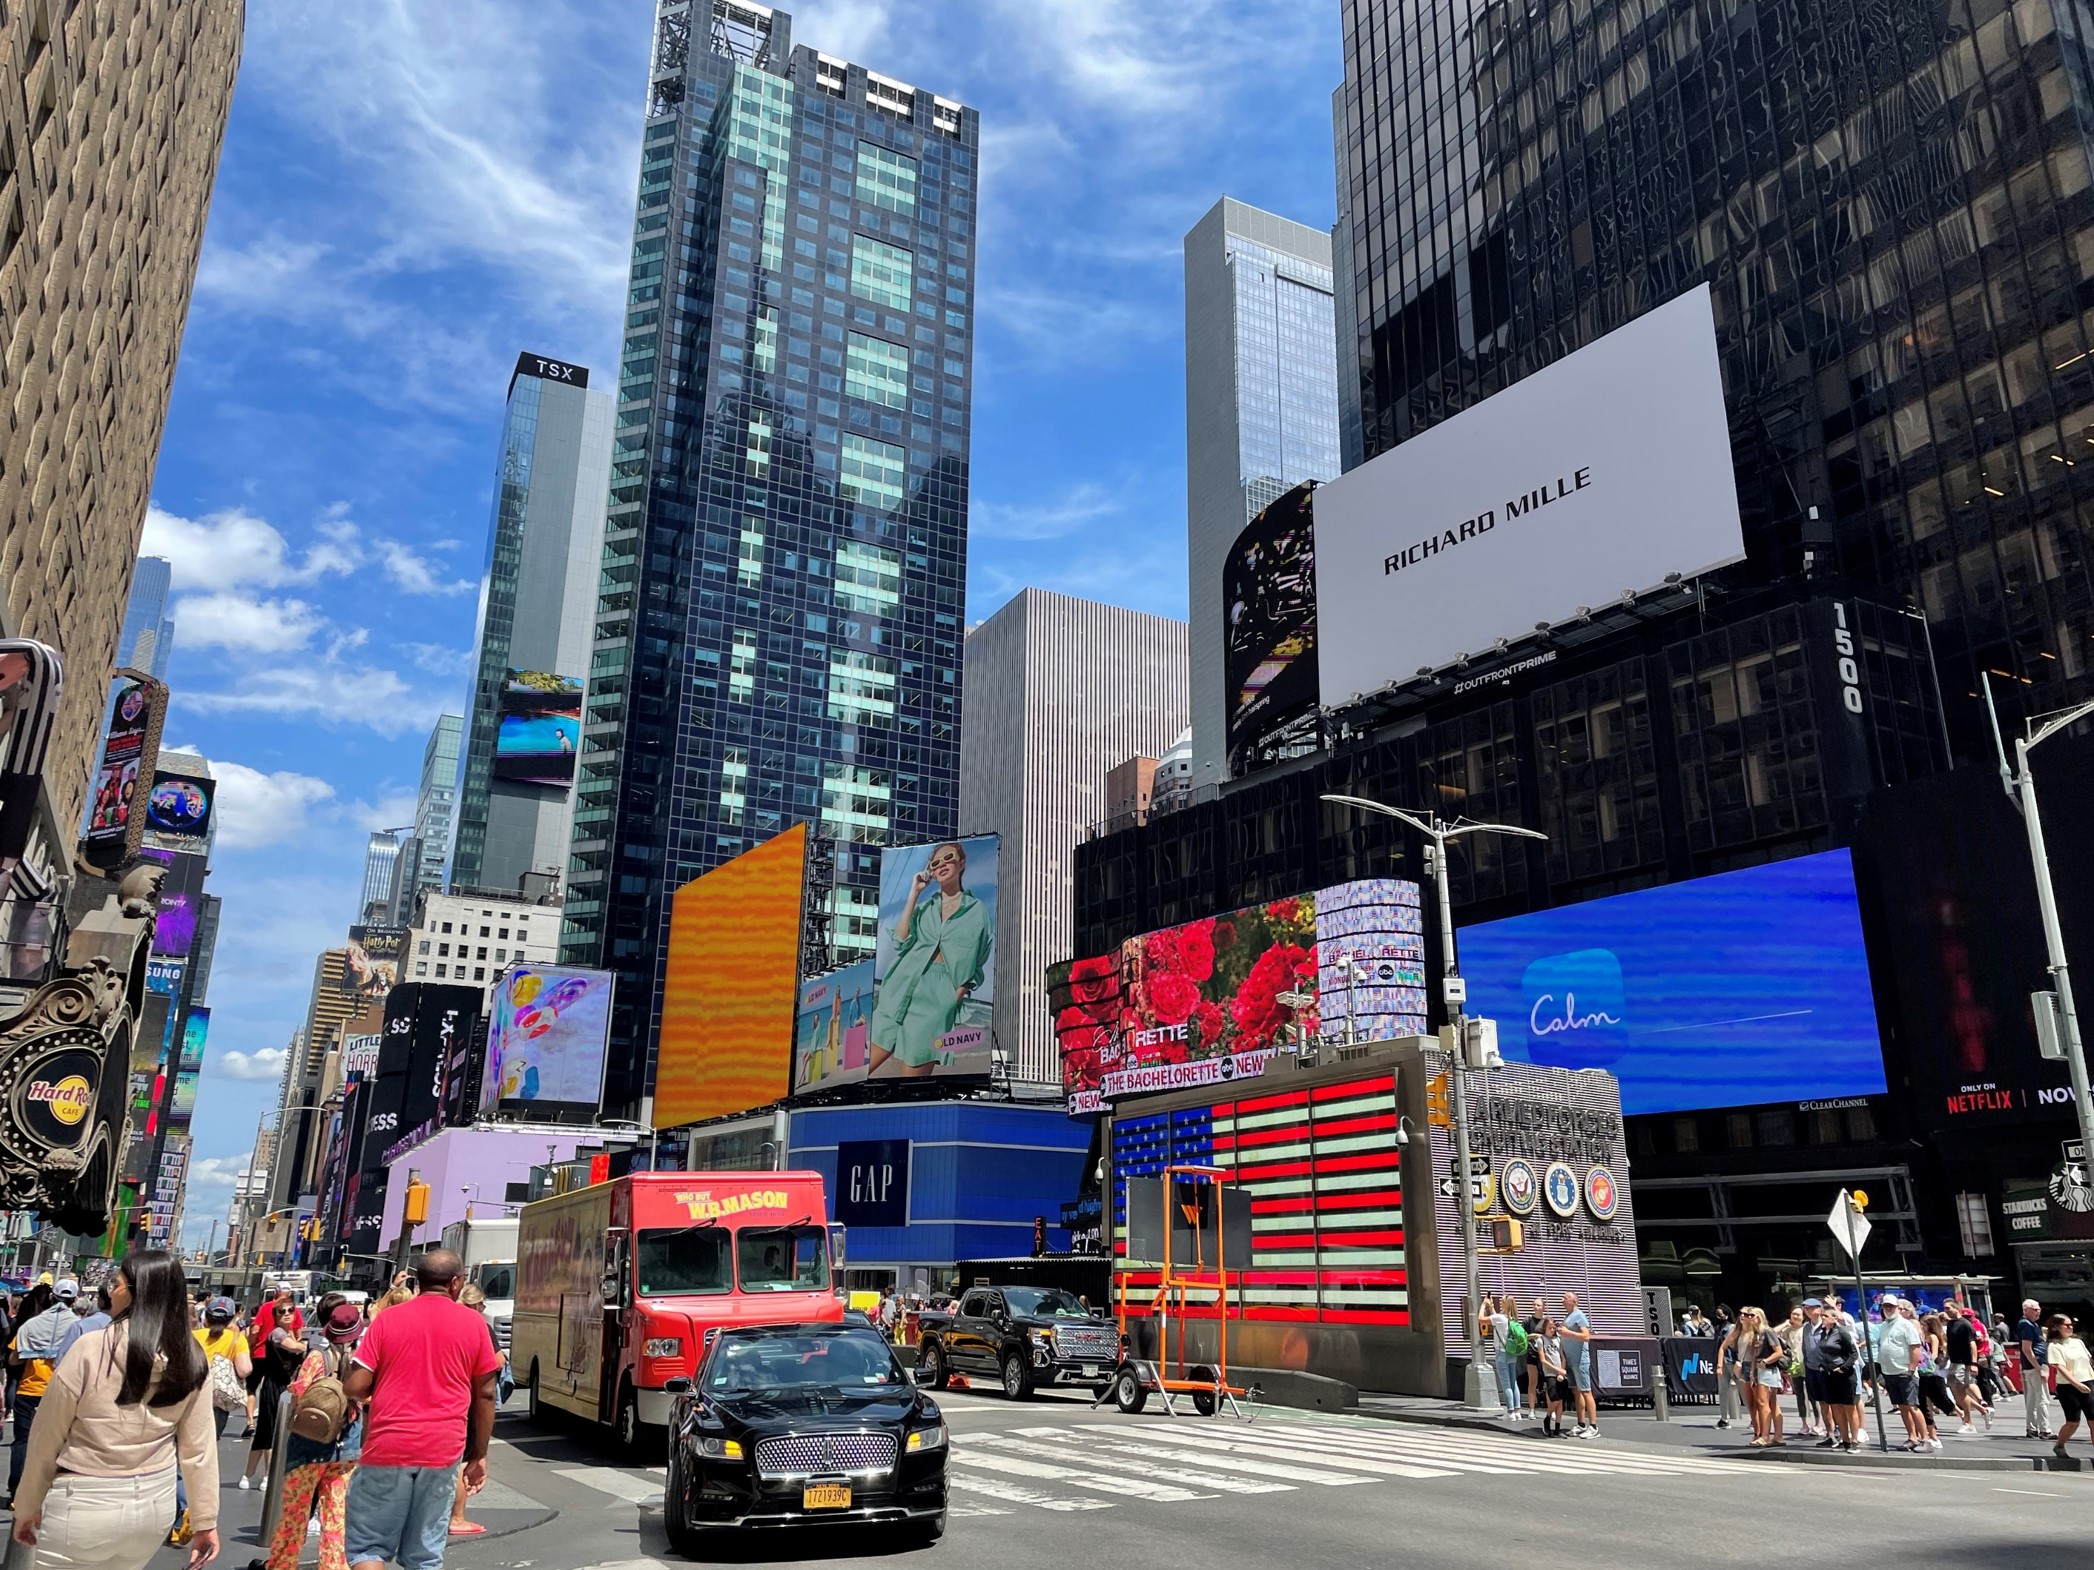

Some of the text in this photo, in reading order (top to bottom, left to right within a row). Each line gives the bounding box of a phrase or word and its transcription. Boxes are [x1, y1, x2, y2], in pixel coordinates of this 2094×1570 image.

[536, 359, 574, 381] TSX
[1384, 466, 1592, 576] RICHARD MILLE
[1833, 602, 1863, 714] 1500
[1453, 650, 1557, 696] #OUTFRONTPRIME
[363, 936, 385, 949] Harry
[1529, 992, 1621, 1036] Calm
[350, 1035, 381, 1051] LITTLE
[956, 1031, 981, 1045] NAVY
[1107, 1074, 1125, 1094] THE
[1127, 1062, 1219, 1089] BACHELORETTE
[1236, 1054, 1264, 1075] NEW
[28, 1081, 95, 1109] Hard Ro
[1960, 1083, 1996, 1093] ONLY ON
[62, 1107, 79, 1116] CAFE
[1947, 1090, 2013, 1115] NETFLIX
[1475, 1095, 1621, 1136] ARMED FORCES
[1549, 1132, 1615, 1159] STATION
[1472, 1162, 1485, 1171] WAY
[850, 1163, 893, 1204] GAP
[1446, 1183, 1459, 1193] ONE
[675, 1192, 711, 1202] WHO BUT
[2002, 1197, 2048, 1215] STARBUCKS
[2011, 1215, 2042, 1230] COFFEE
[1034, 1217, 1042, 1252] EAT
[1621, 1366, 1639, 1374] SQUARE
[1622, 1358, 1637, 1366] TIMES
[808, 1489, 848, 1503] T721939C
